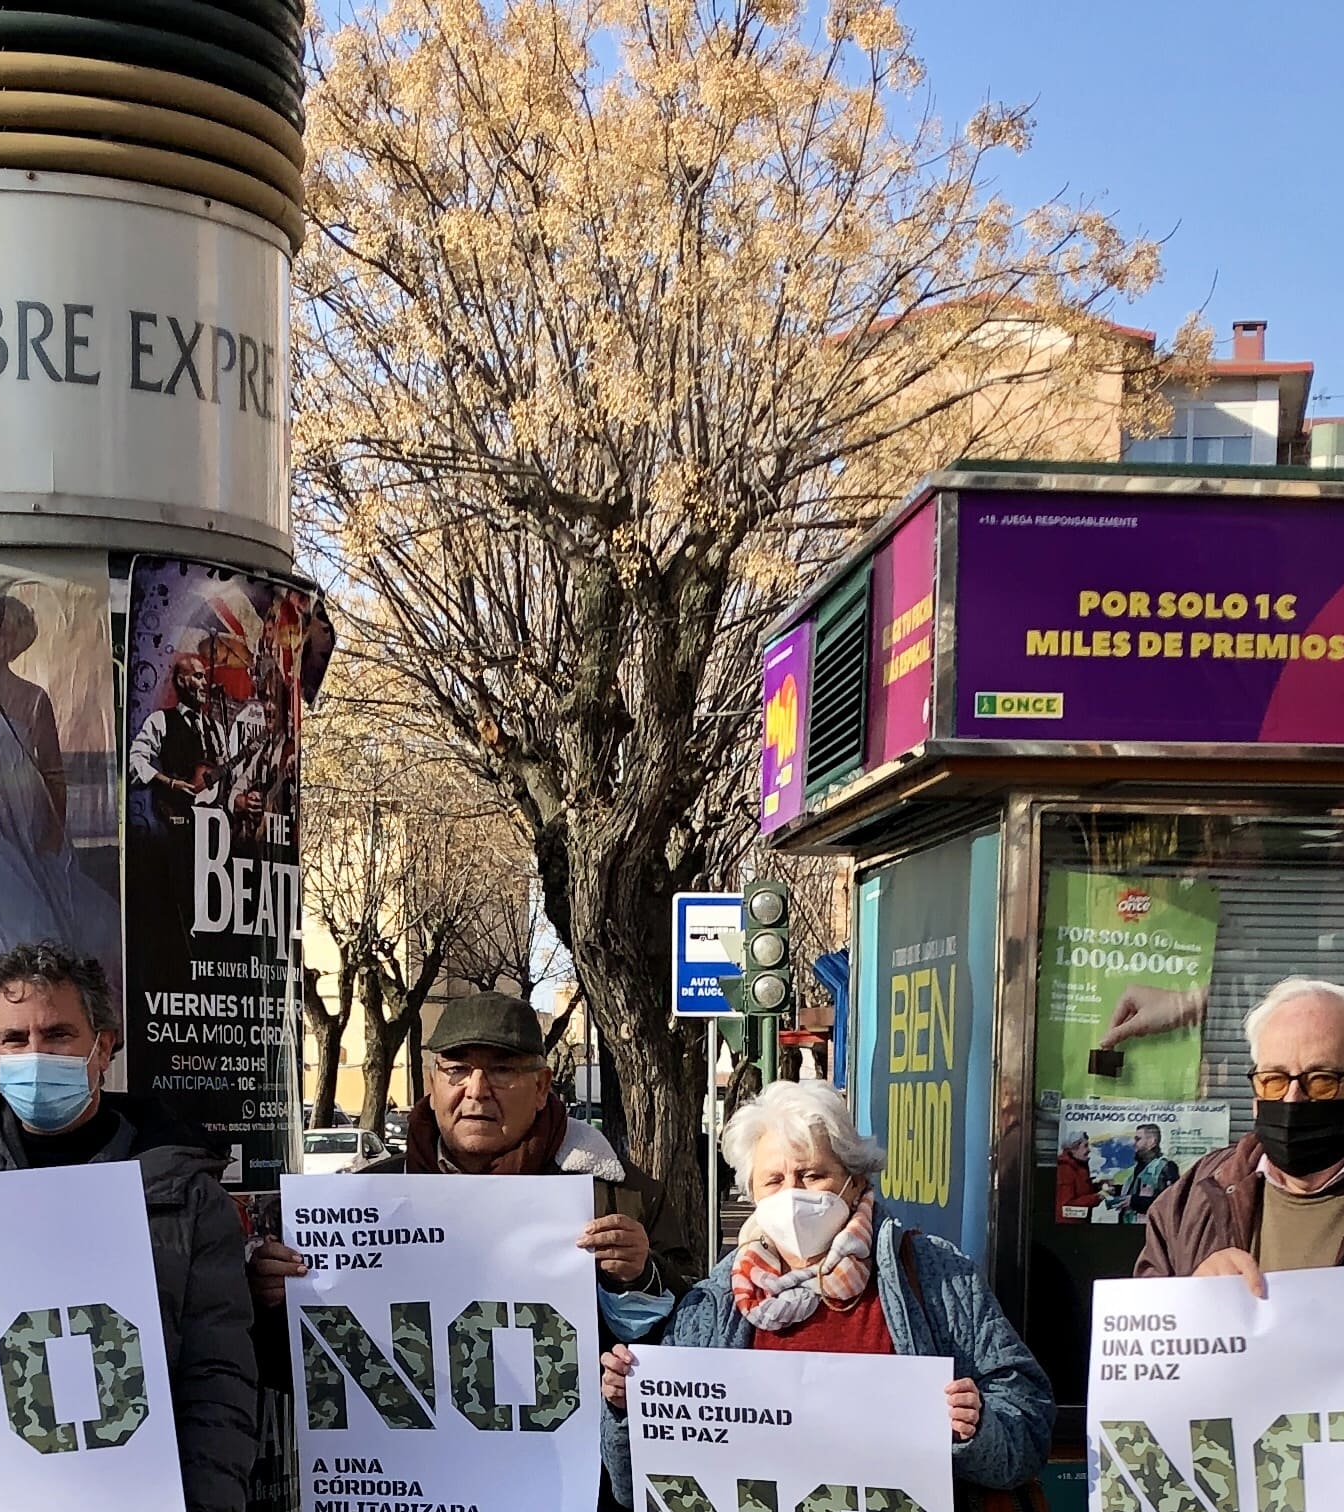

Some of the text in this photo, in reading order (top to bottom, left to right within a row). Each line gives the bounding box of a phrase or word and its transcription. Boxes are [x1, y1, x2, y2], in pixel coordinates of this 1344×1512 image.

[1001, 514, 1033, 527] JUEGA
[1035, 515, 1138, 529] RESPONSABLEMENTE
[1078, 590, 1297, 621] POR SOLO 1€
[1025, 629, 1132, 658] MILES
[1138, 631, 1184, 659] DE
[1000, 697, 1058, 713] ONCE
[264, 812, 290, 845] THE
[1099, 930, 1147, 947] SOLO
[190, 960, 248, 980] THE SILVER
[690, 977, 719, 986] AUTO
[682, 988, 694, 996] DE
[145, 992, 237, 1018] VIERNES
[241, 996, 254, 1018] 11
[889, 963, 956, 1073] BIEN
[147, 1022, 246, 1048] SALA M100,
[171, 1055, 266, 1072] SHOW 21.30 HS
[152, 1075, 229, 1091] ANTICIPADA
[237, 1077, 256, 1091] 10€
[1065, 1112, 1125, 1122] CONTAMOS
[880, 1081, 952, 1208] JUGADO
[295, 1207, 379, 1224] SOMOS
[296, 1227, 445, 1247] UNA CIUDAD
[336, 1252, 383, 1270] PAZ
[1103, 1314, 1177, 1333] SOMOS
[1102, 1336, 1247, 1357] UNA CIUDAD
[300, 1301, 580, 1432] NO
[1101, 1363, 1180, 1380] DE PAZ
[640, 1379, 727, 1399] SOMOS
[641, 1402, 792, 1426] UNA CIUDAD
[643, 1424, 729, 1443] DE PAZ
[312, 1458, 383, 1474] A UNA
[314, 1476, 423, 1497] CÓRDOBA
